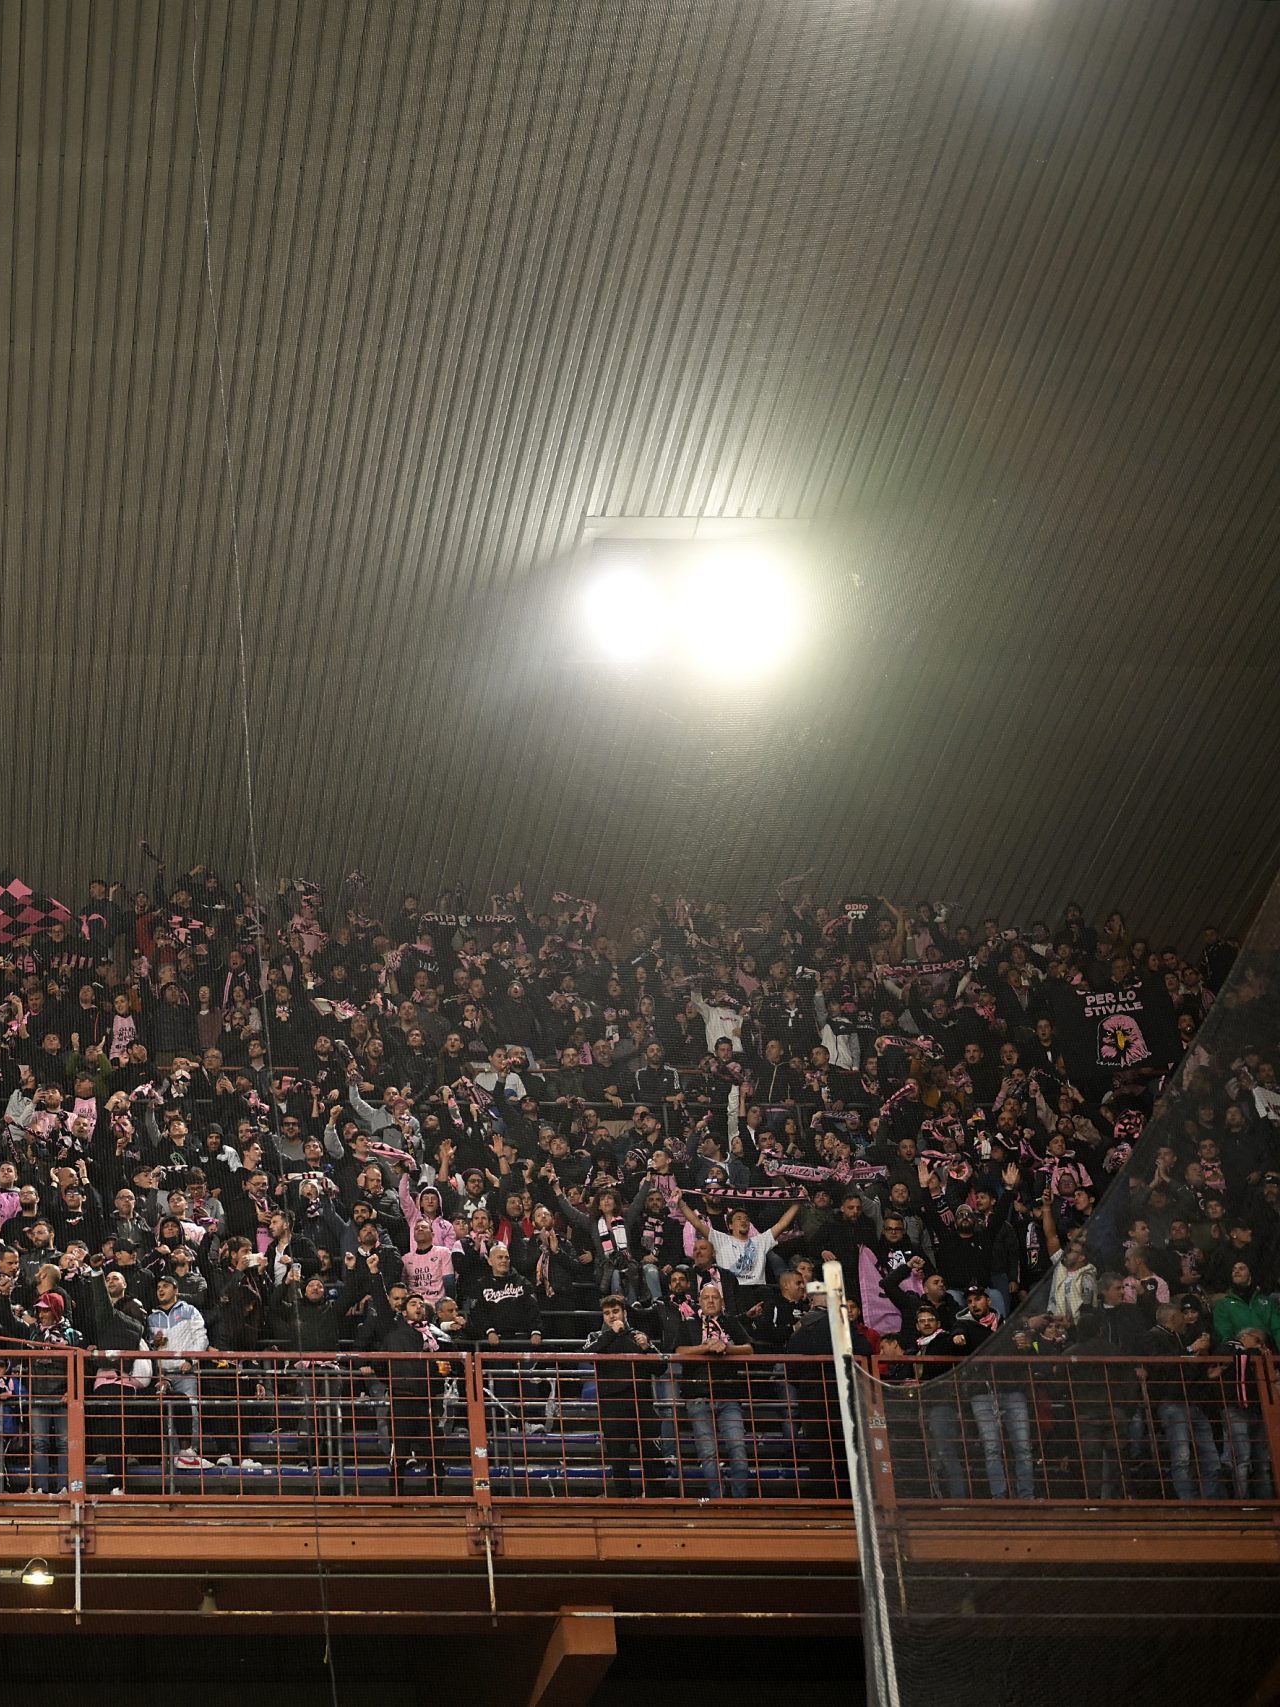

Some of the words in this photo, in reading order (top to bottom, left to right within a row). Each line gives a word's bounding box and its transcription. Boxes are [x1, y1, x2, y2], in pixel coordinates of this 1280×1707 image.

[848, 910, 866, 920] CT
[1086, 992, 1116, 1005] PER
[1119, 990, 1137, 1002] LO
[1084, 1001, 1144, 1017] STIVALE
[483, 1283, 524, 1303] Brooklyn
